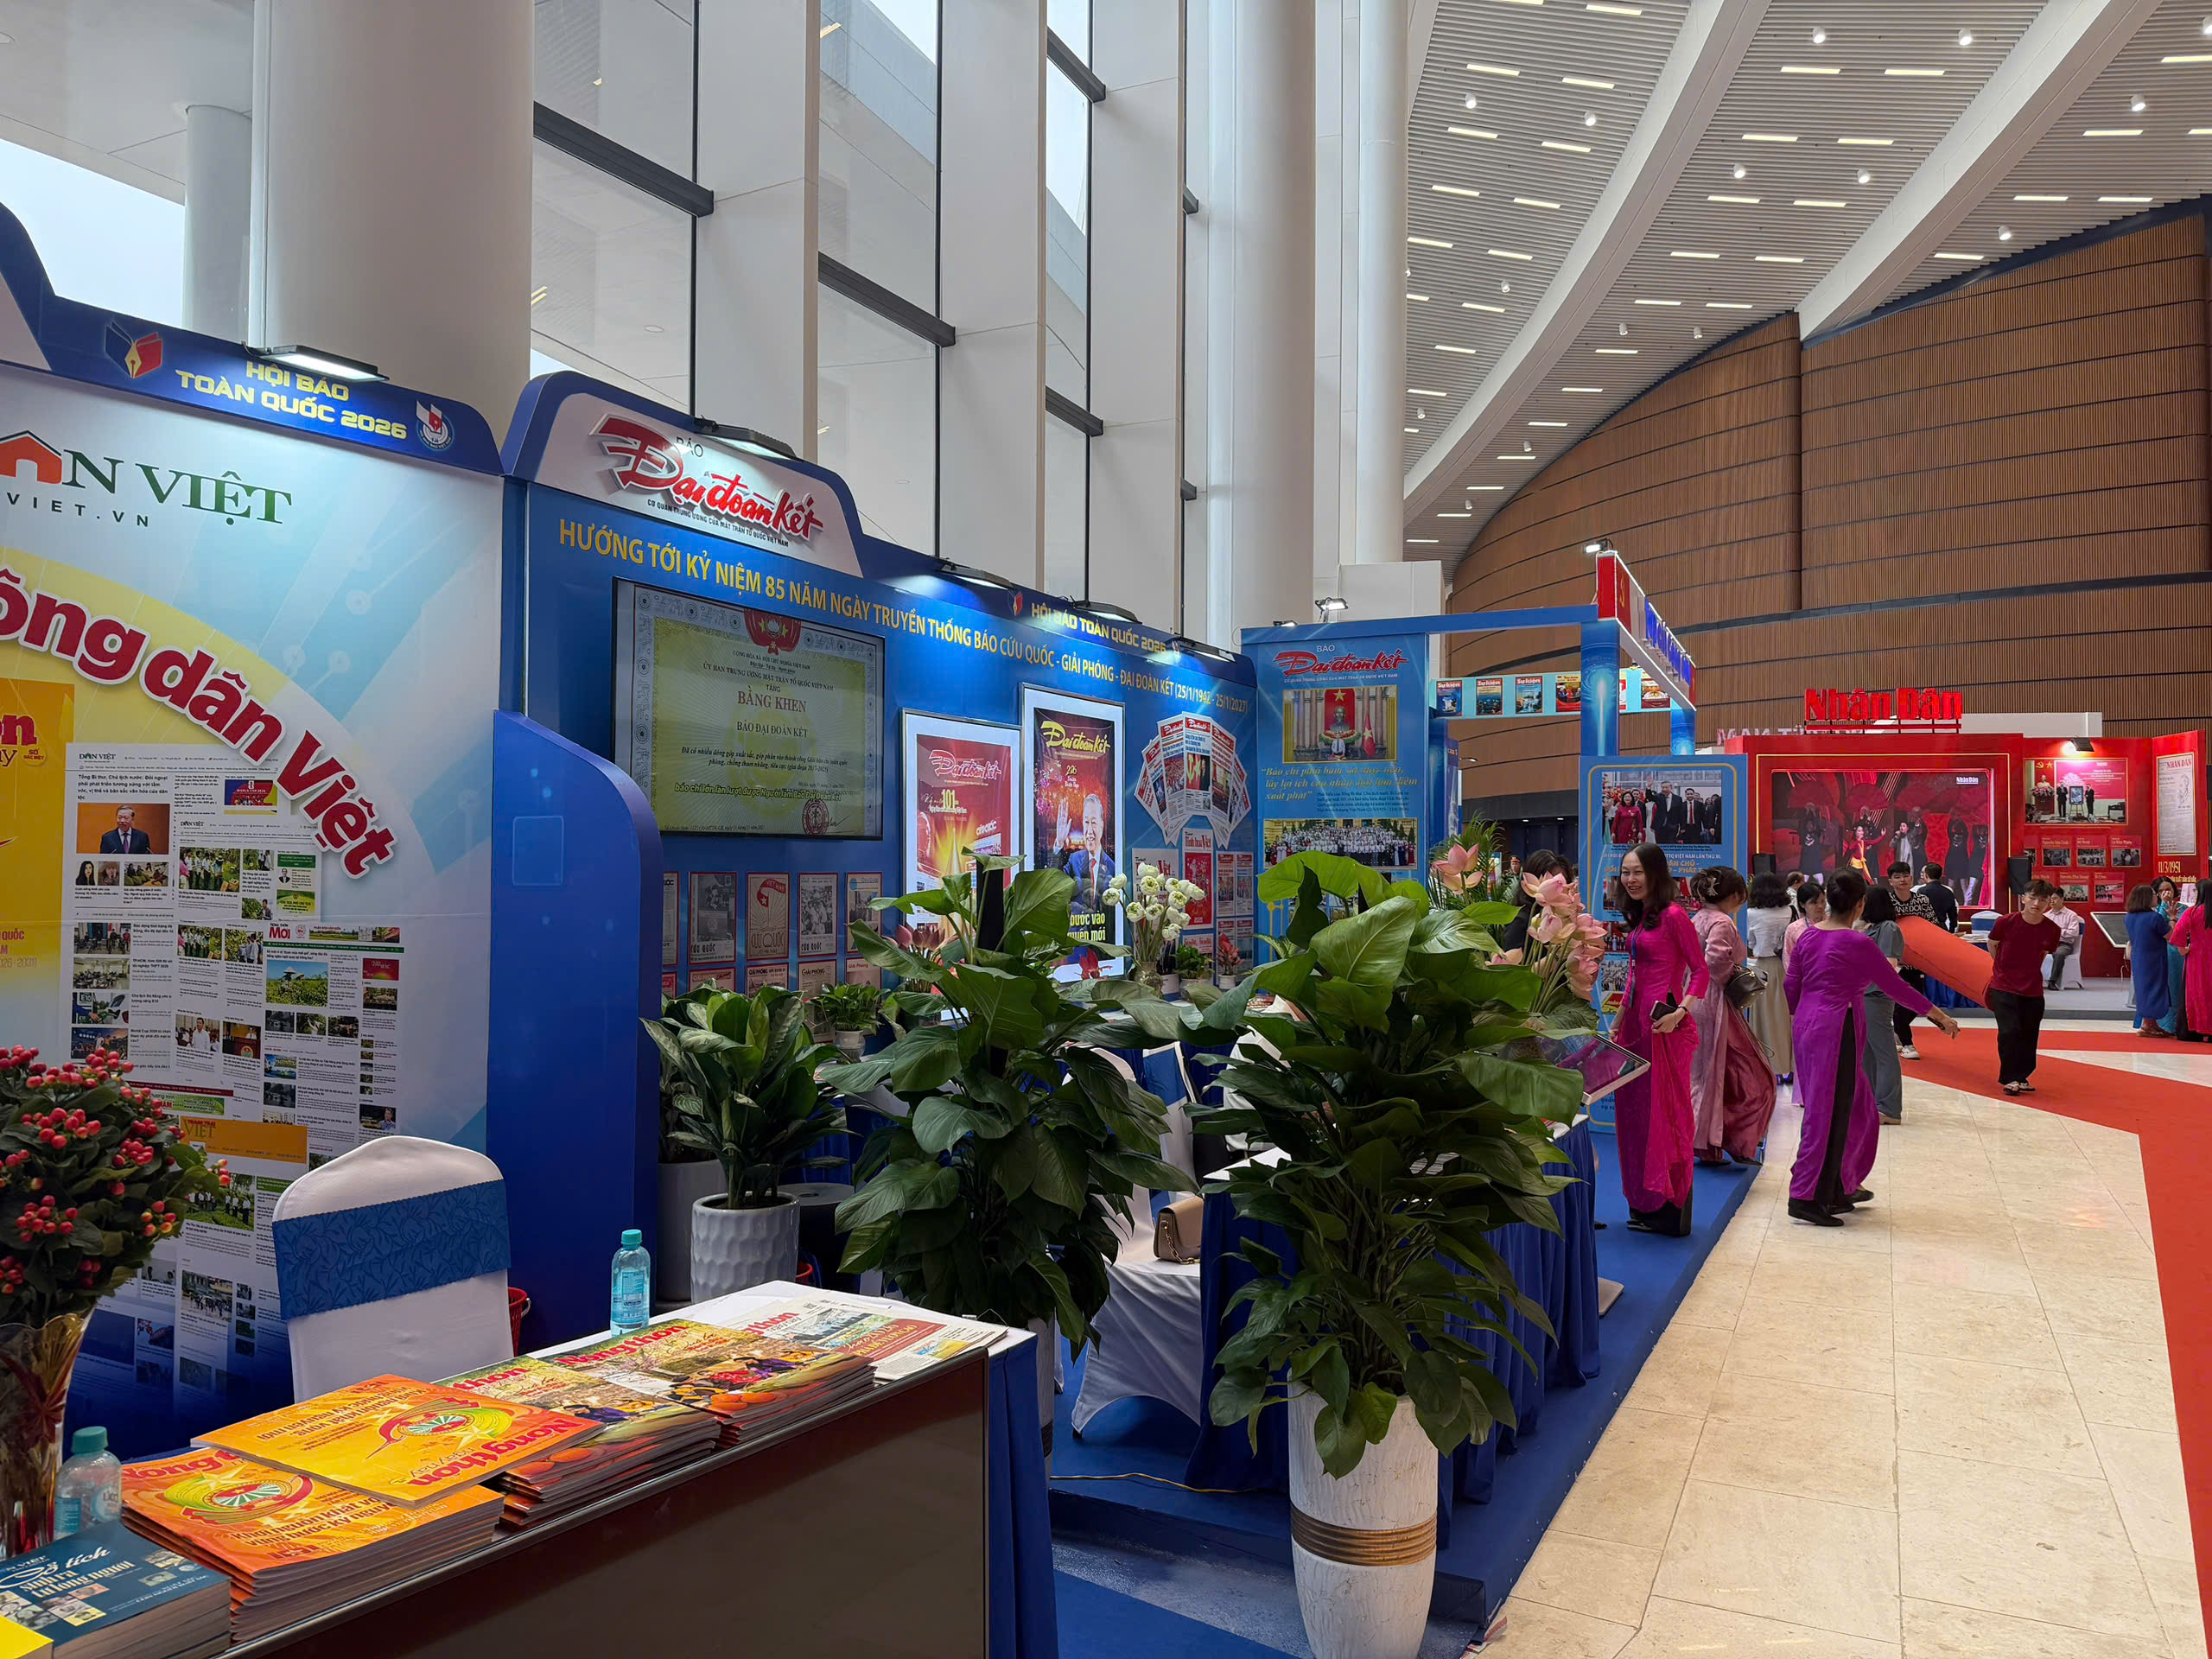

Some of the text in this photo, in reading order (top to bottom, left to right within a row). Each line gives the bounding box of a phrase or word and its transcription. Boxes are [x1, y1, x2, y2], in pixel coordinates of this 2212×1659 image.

[247, 360, 349, 401] HỘI BÁO
[175, 370, 407, 440] TOÀN QUỐC 2026
[136, 470, 292, 525] VIỆT
[778, 539, 789, 548] NAM
[560, 518, 645, 566] HƯỚNG
[648, 542, 681, 574] TỚI
[687, 550, 711, 582] KỶ
[716, 562, 761, 596] NIỆM
[766, 575, 785, 601] 85
[790, 581, 827, 610] NĂM
[831, 593, 870, 622] NGÀY
[873, 601, 926, 638] TRUYỀN
[928, 614, 972, 648] THỐNG
[974, 629, 998, 655] BÁO
[1000, 635, 1024, 661] CỨU
[1025, 643, 1055, 669] QUỐC
[1061, 651, 1081, 674] GIẢI
[1082, 659, 1115, 683] PHÓNG
[1120, 670, 1135, 690] ĐẠI
[1135, 673, 1159, 692] ĐOÀN
[1160, 676, 1174, 696] KẾT
[1032, 603, 1166, 652] HỘI BÁO TOÀN QUỐC 2026
[1316, 645, 1335, 653] BÁO
[713, 664, 726, 672] BAN
[726, 667, 745, 677] TRUNG
[737, 685, 807, 713] BẰNG KHEN
[1804, 687, 1963, 721] Nhân Dân
[736, 720, 809, 738] BÁO ĐẠI ĐOÀN KẾT
[143, 648, 283, 765] dân
[277, 730, 396, 878] Việt
[941, 789, 956, 809] 101
[2158, 861, 2181, 874] 11/3/1951
[1091, 910, 1106, 925] vào
[1090, 926, 1106, 942] mới
[349, 1501, 395, 1524] nguy
